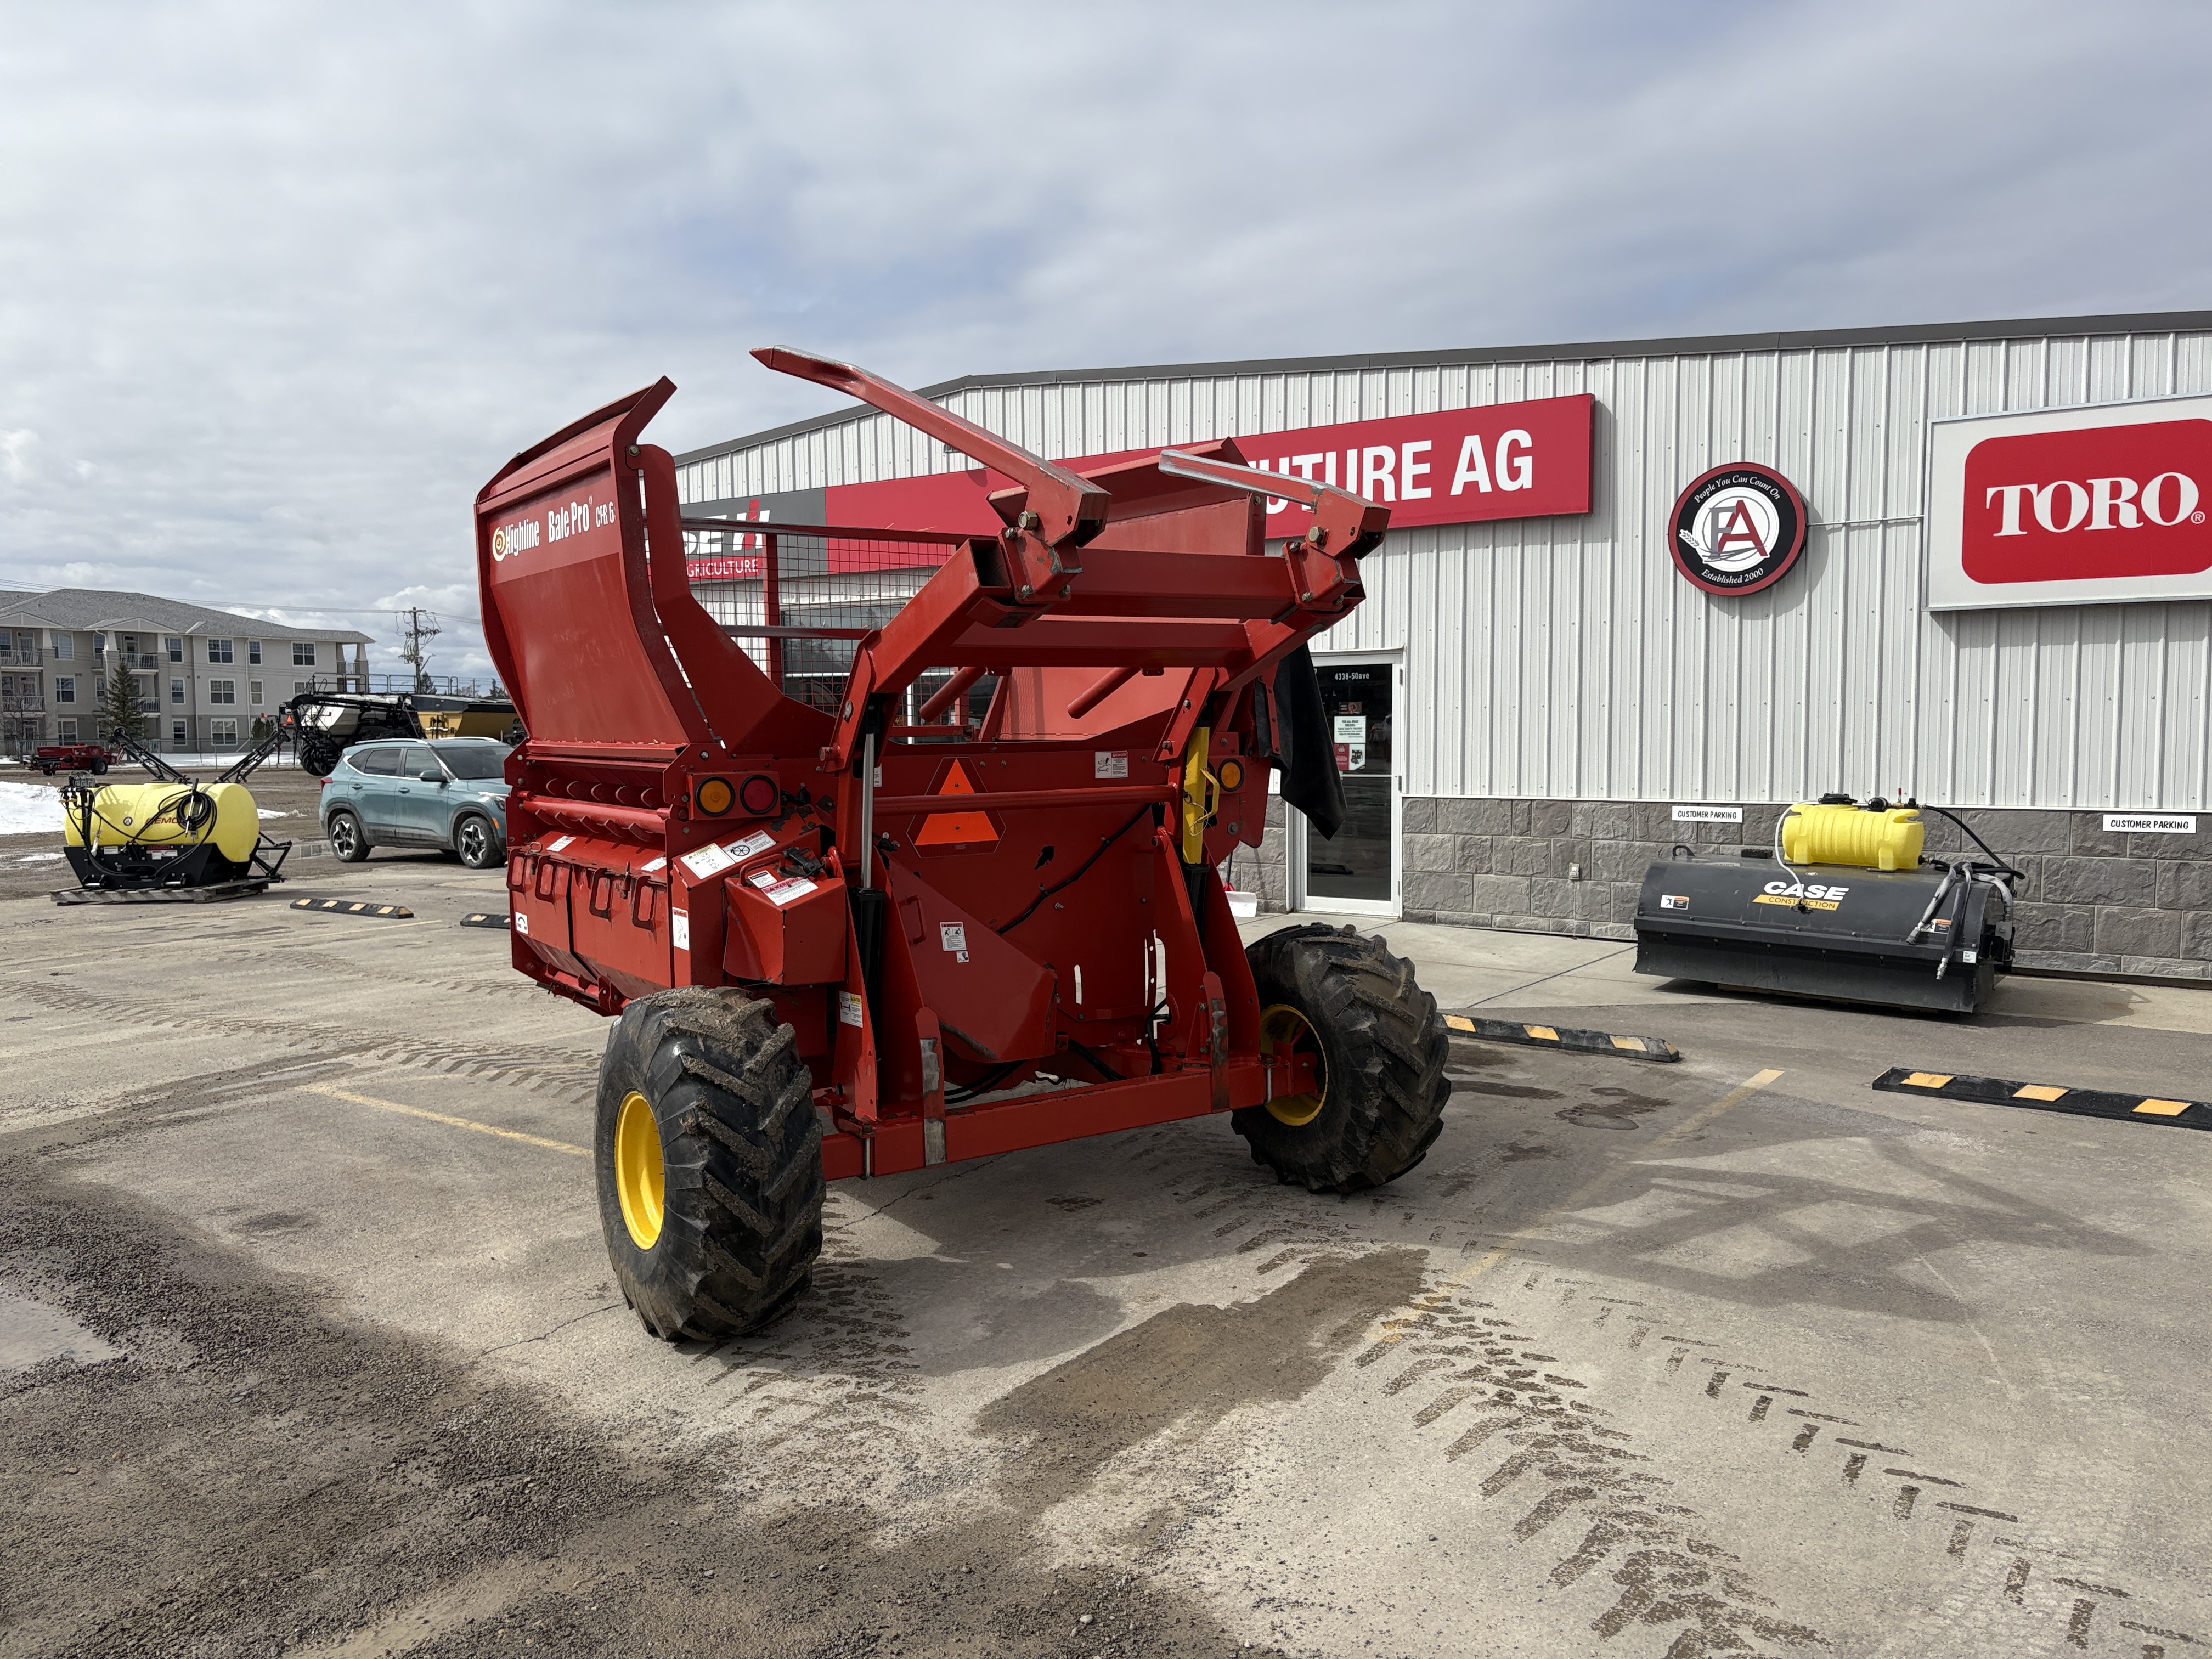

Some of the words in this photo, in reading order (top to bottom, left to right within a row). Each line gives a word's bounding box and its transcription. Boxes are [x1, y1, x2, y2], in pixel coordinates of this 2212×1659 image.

[1246, 440, 1432, 514] UTURE
[1450, 429, 1533, 496] AG
[1694, 484, 1716, 503] People
[1716, 478, 1730, 488] You
[1732, 475, 1748, 483] Can
[1749, 477, 1771, 492] Count
[1770, 488, 1781, 500] On
[505, 518, 540, 556] Highline
[549, 506, 569, 543] Bale
[595, 504, 608, 528] CFR
[686, 558, 758, 578] GRICULTURE
[1701, 569, 1742, 584] Established
[1745, 568, 1763, 582] 2000
[1334, 672, 1370, 680] 4338-50ave
[1678, 810, 1709, 819] CUSTOMER
[1710, 811, 1737, 819] PARKING
[2111, 819, 2151, 828] CUSTOMER
[2153, 821, 2189, 830] PARKING
[774, 878, 800, 889] WARNING
[1764, 881, 1849, 901] CASE
